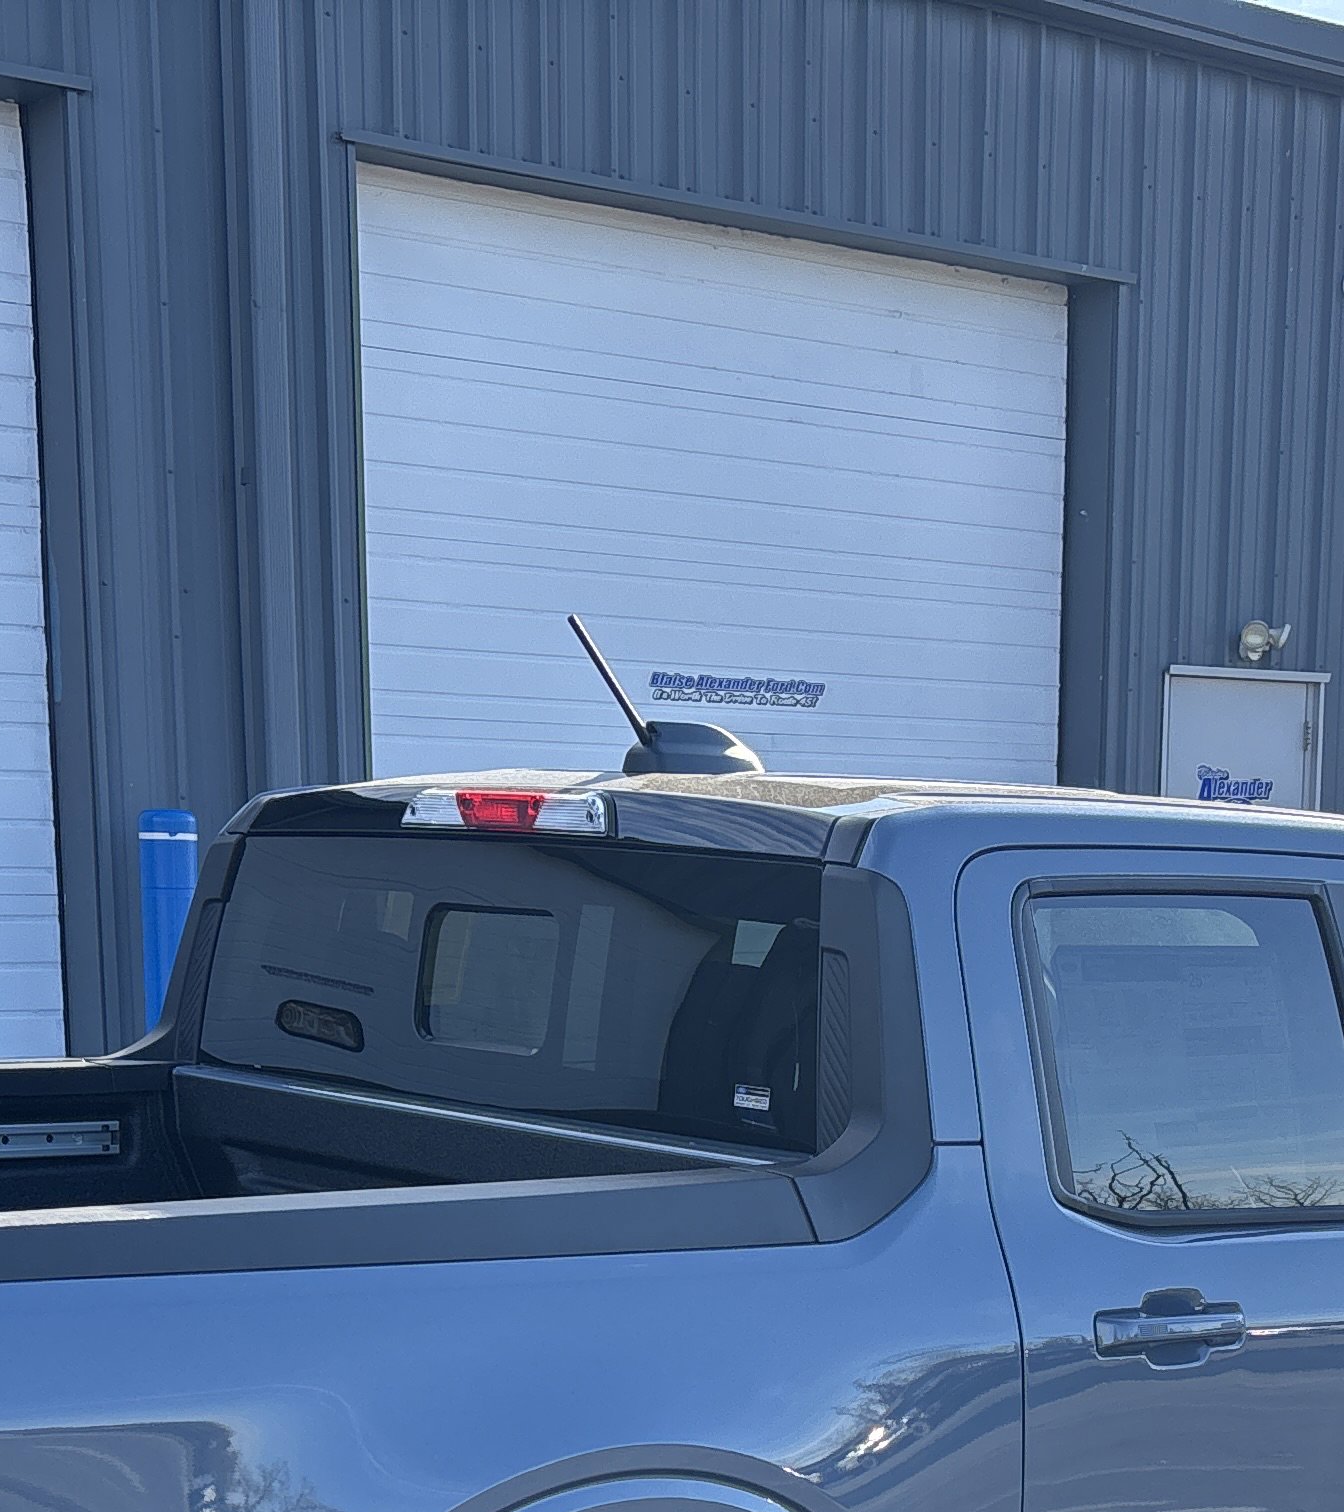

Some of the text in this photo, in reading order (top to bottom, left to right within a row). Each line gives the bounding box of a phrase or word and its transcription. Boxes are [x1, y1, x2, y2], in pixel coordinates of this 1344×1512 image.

[650, 672, 695, 689] Blaise
[695, 674, 765, 693] Alexander
[1198, 777, 1272, 800] Alexander
